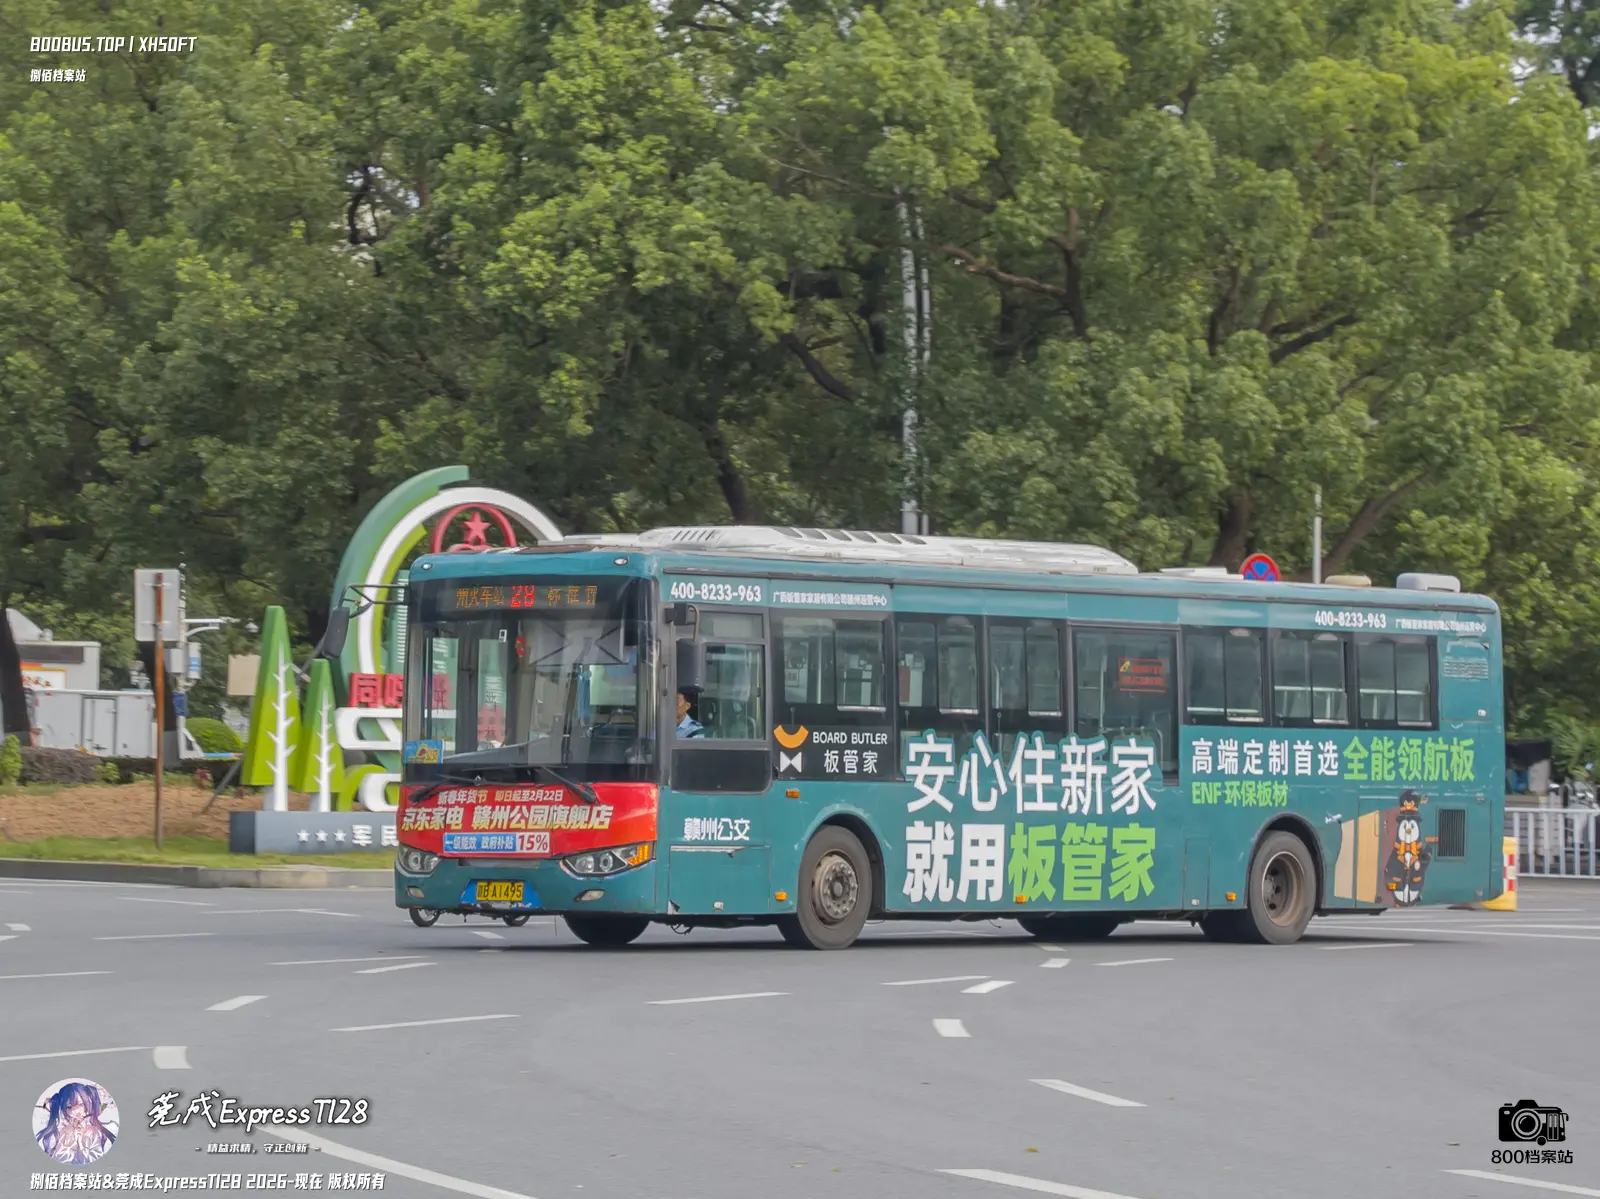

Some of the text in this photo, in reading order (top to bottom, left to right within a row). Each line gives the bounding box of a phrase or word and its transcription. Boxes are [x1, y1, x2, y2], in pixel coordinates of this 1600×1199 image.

[510, 584, 535, 608] 28
[670, 581, 762, 603] 400-8233-963
[1314, 610, 1387, 629] 400-8233-963
[812, 730, 888, 746] BOARD BUTLER
[823, 748, 879, 774] 板管家
[1191, 735, 1476, 782] 高端定制首选 全能领航板
[904, 729, 1158, 816] 安心住新家
[437, 788, 564, 805] 新春年货节 即日起至2月22日
[1191, 779, 1289, 808] ENF 环保板材
[401, 804, 614, 832] 京东家电 赣州公园旗舰店
[683, 817, 751, 842] 赣州公交
[480, 834, 516, 851] 政府补贴
[517, 833, 550, 853] 15%
[902, 820, 1157, 903] 就用板管家
